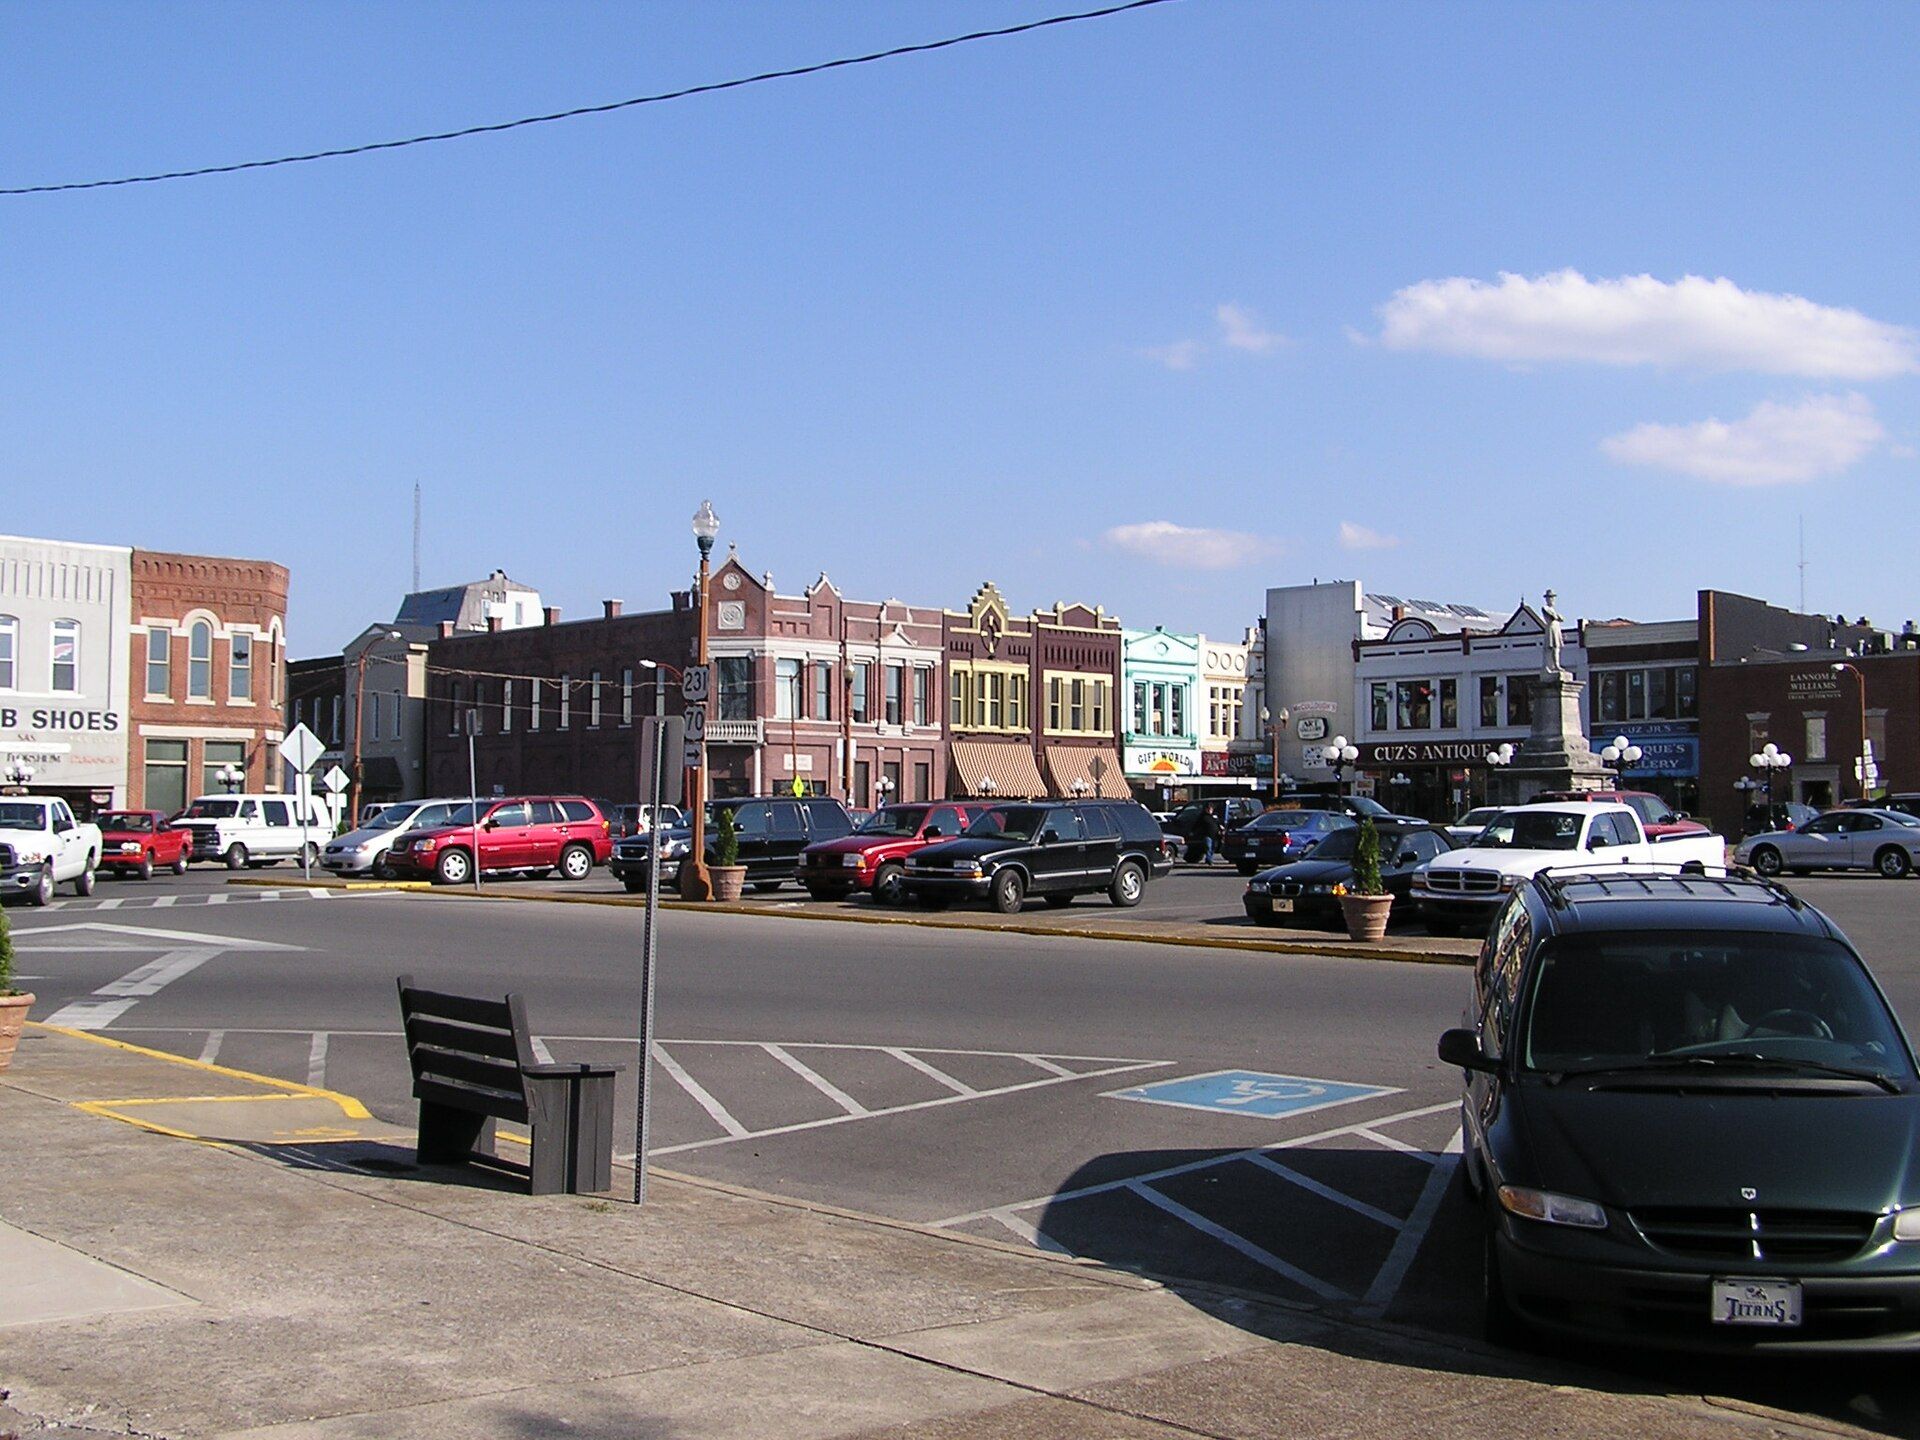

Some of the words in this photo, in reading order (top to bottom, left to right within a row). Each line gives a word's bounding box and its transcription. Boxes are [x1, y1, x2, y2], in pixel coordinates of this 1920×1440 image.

[684, 672, 707, 692] 231
[1790, 673, 1829, 681] LANNOM
[1790, 682, 1837, 690] WILLIAMS
[1, 708, 18, 729] B
[31, 709, 119, 732] SHOES
[686, 711, 705, 731] 70
[1137, 751, 1157, 765] GIFT
[1160, 751, 1191, 767] WORLD
[1374, 745, 1417, 761] CUZ'S
[1726, 1297, 1786, 1322] TITANS
